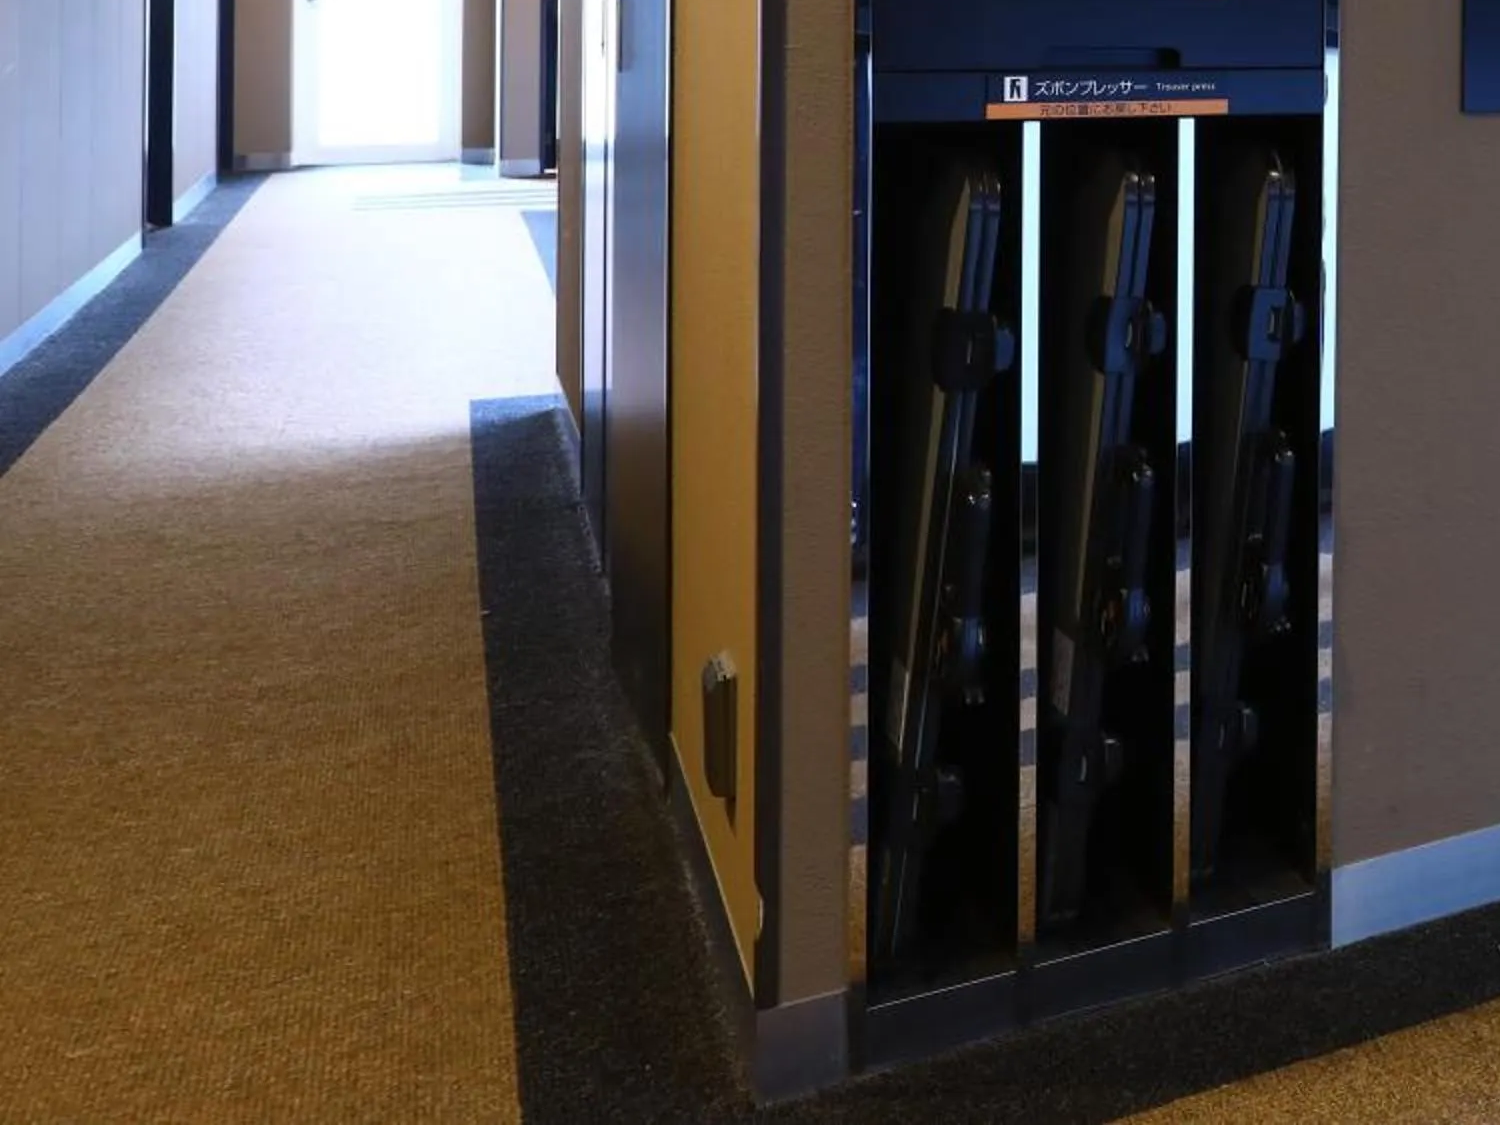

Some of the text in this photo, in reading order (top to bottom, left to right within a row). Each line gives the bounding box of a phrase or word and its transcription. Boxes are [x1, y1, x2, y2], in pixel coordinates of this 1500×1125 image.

[1034, 79, 1149, 97] ズボンプレッサー
